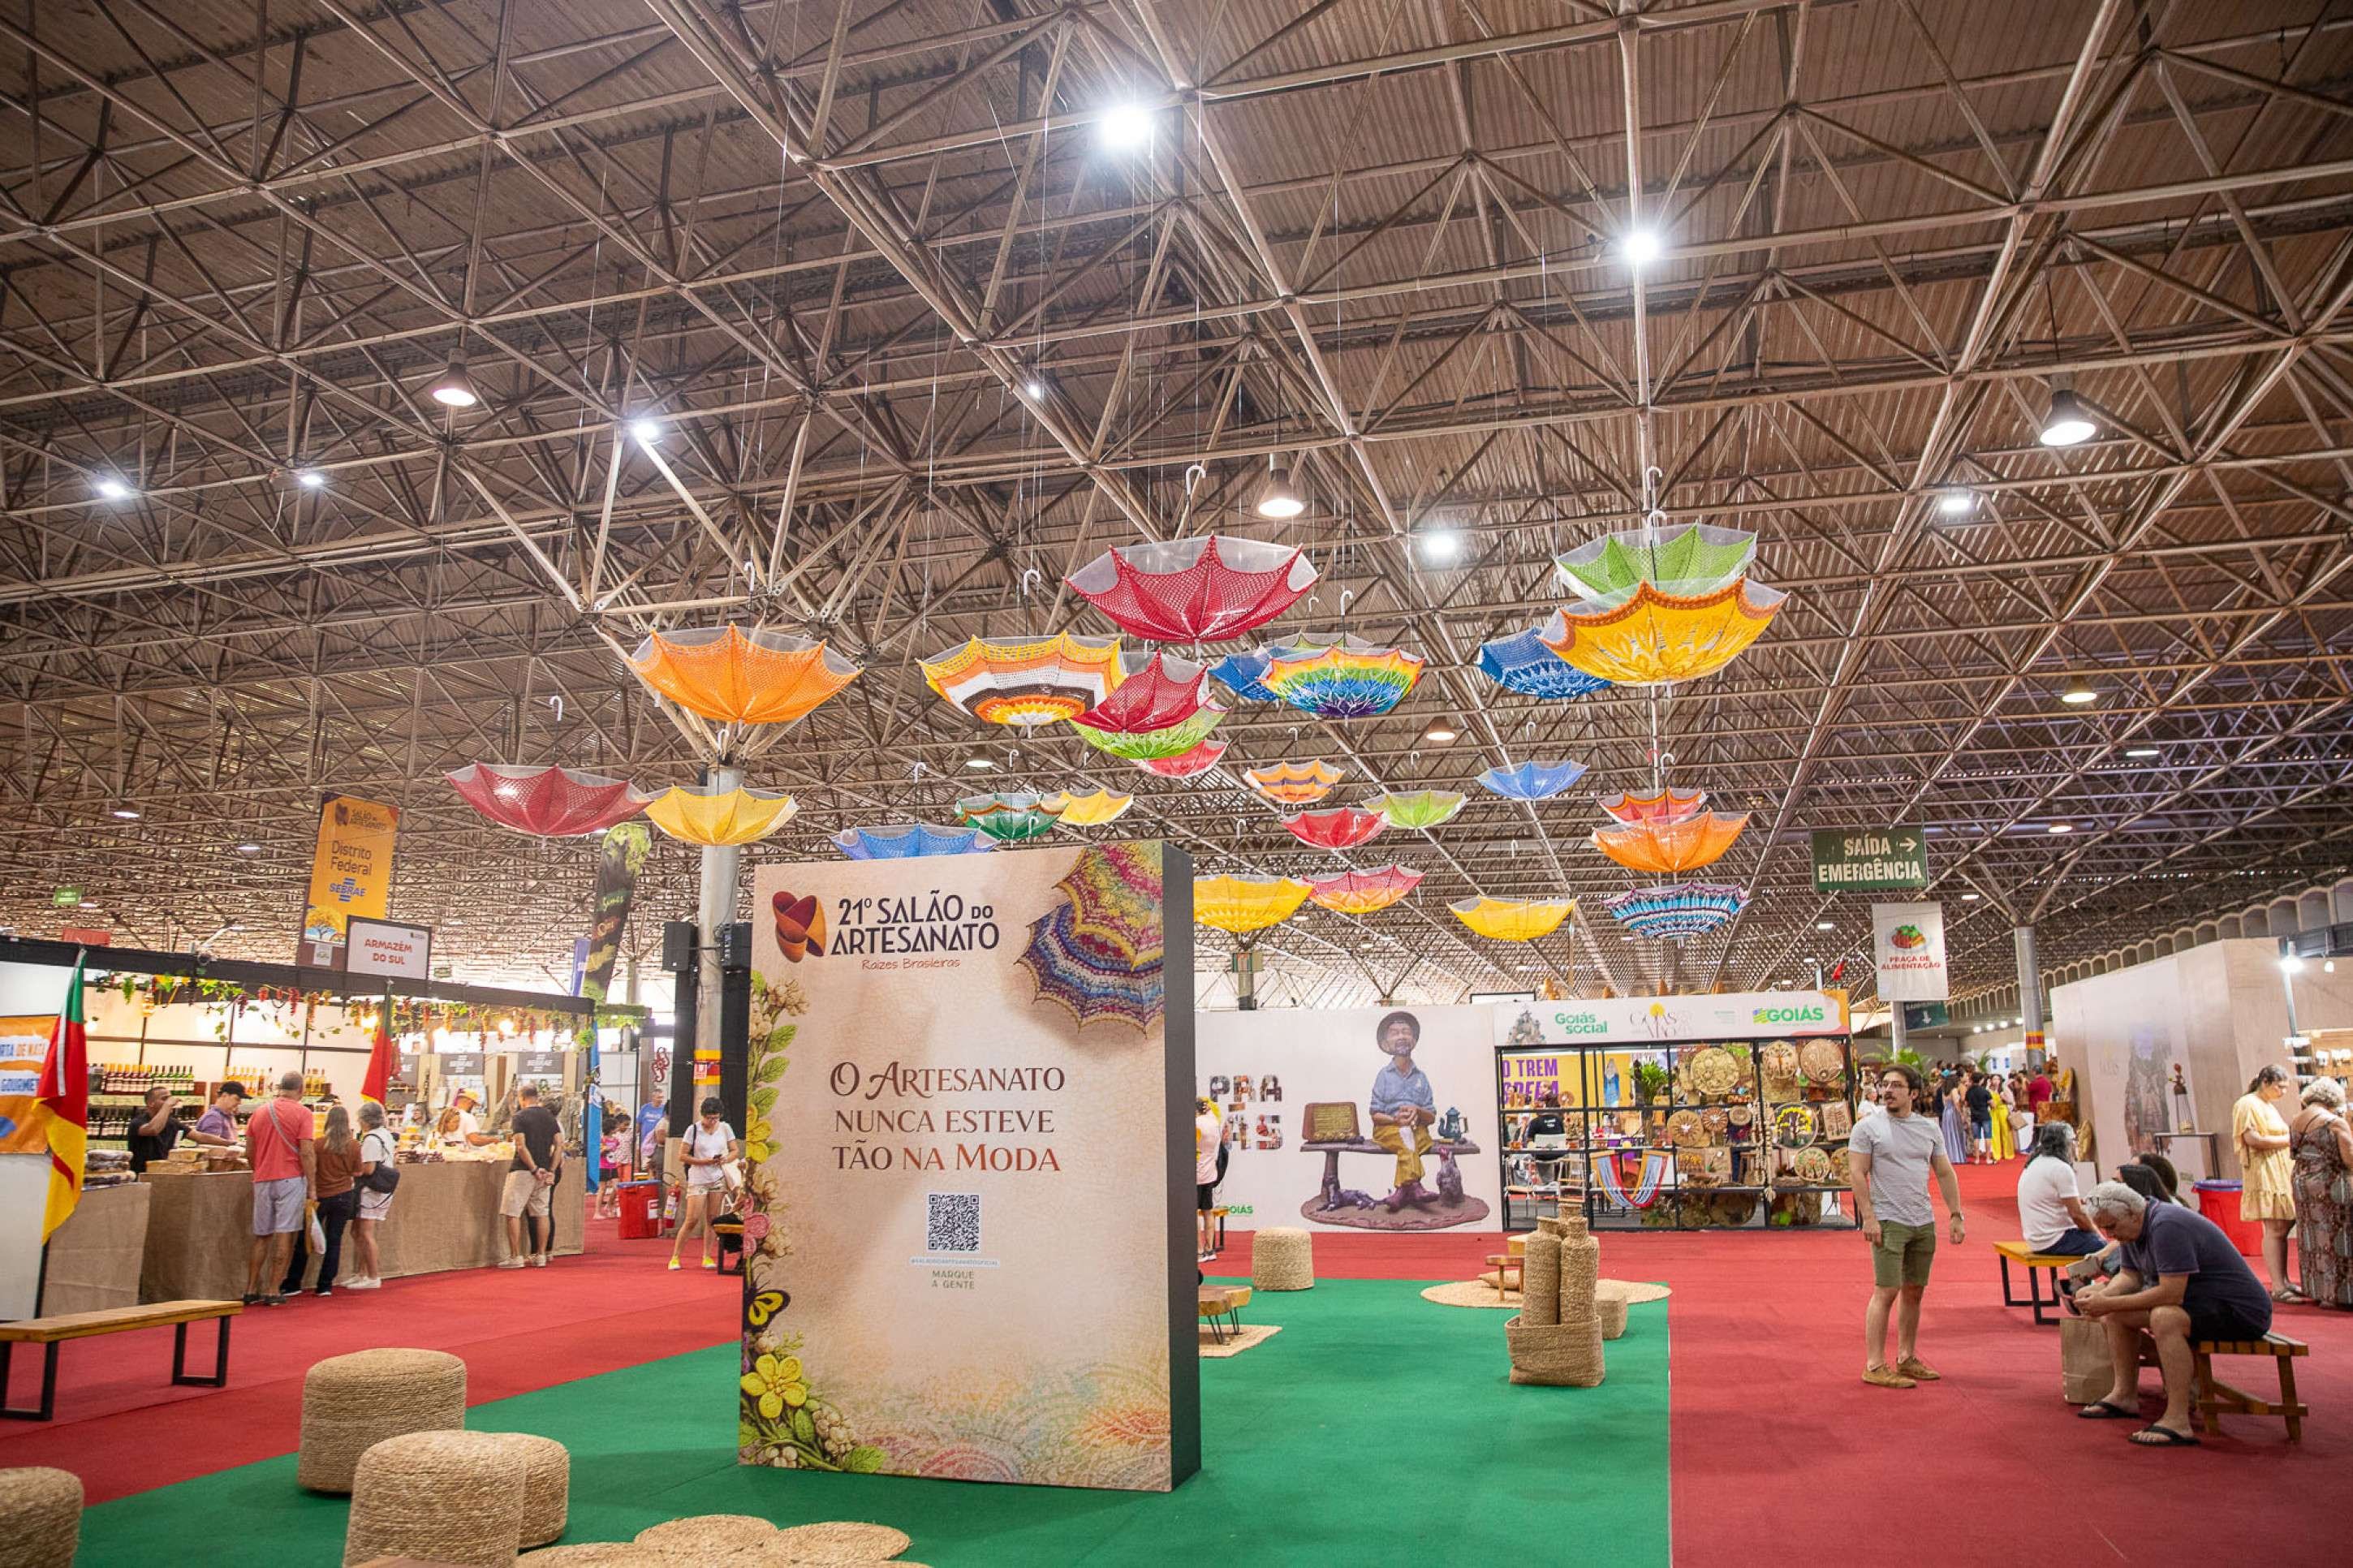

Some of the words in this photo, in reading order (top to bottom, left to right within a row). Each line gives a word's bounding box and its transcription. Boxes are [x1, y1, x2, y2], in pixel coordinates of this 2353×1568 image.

[331, 840, 373, 859] Distrito
[1843, 834, 1891, 856] SAÍDA
[330, 856, 372, 877] Federal
[1818, 858, 1922, 883] EMERGÊNCIA
[329, 882, 366, 898] SEBRAE
[838, 898, 872, 925] 21º
[877, 890, 963, 924] SALÃO
[971, 905, 993, 920] DO
[364, 937, 412, 954] ARMAZÉM
[830, 922, 1000, 956] ARTESANATO
[372, 952, 386, 963] DO
[388, 953, 406, 965] SUL
[1881, 961, 1941, 970] ALIMENTAÇÃO
[1555, 1011, 1597, 1024] Goiás
[1766, 1006, 1824, 1021] GOIÁS
[1566, 1021, 1608, 1035] social
[1516, 1058, 1558, 1076] TREM
[830, 1062, 860, 1096] O
[865, 1062, 1065, 1100] ARTESANATO
[1210, 1075, 1282, 1102] PRA
[835, 1110, 936, 1133] NUNCA
[946, 1110, 1055, 1133] ESTEVE
[832, 1139, 892, 1170] TÃO
[903, 1148, 945, 1170] NA
[956, 1144, 1061, 1171] MODA
[932, 1270, 974, 1279] MARQUE
[942, 1281, 975, 1289] GENTE
